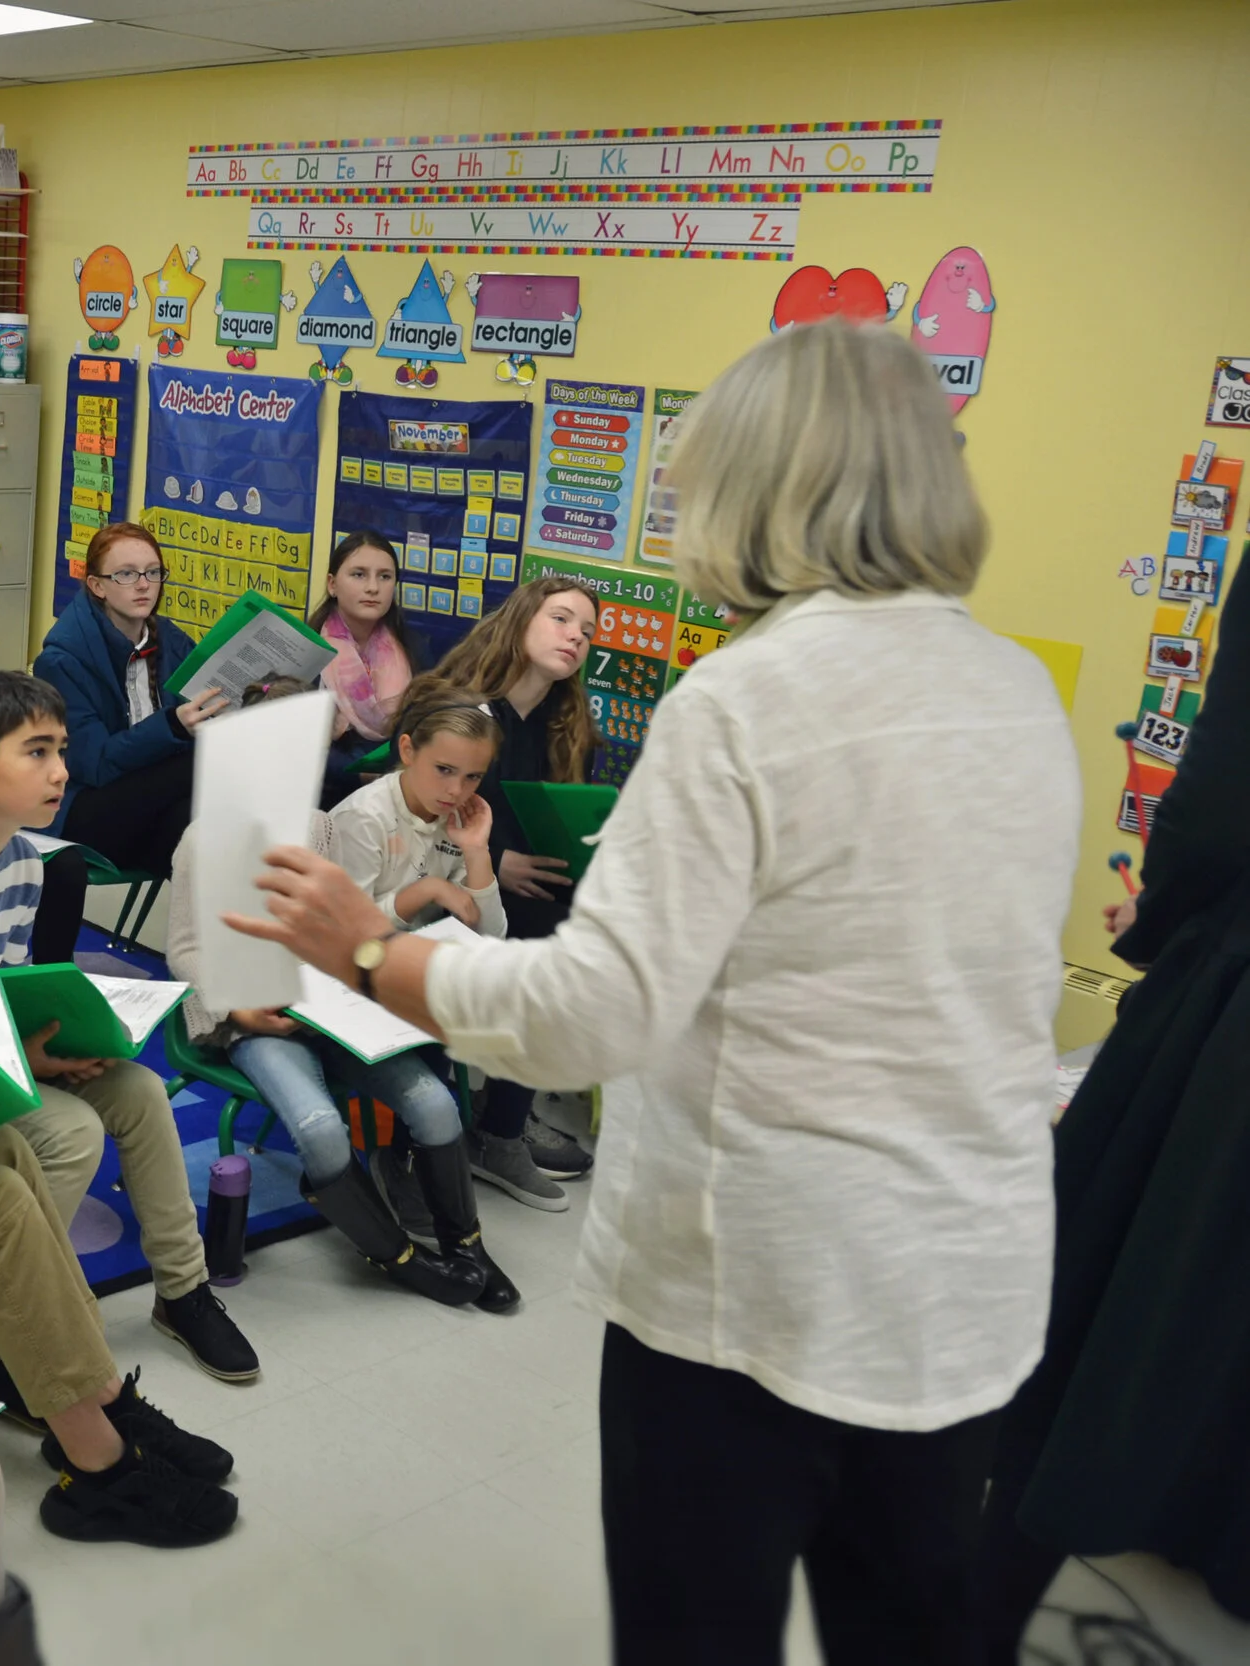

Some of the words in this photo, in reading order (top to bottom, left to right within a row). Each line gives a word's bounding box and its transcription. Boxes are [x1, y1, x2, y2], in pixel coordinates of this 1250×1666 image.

[196, 162, 216, 182] Aa
[228, 159, 247, 182] Bb
[261, 158, 281, 180] Cc
[296, 157, 318, 180] Dd
[336, 157, 356, 179] Ee
[375, 155, 393, 178] Ff
[411, 154, 439, 183] Gg
[457, 153, 482, 177] Hh
[505, 151, 523, 176] Ii
[550, 151, 569, 181] Jj
[600, 148, 628, 174] Kk
[660, 147, 682, 174] Ll
[708, 147, 751, 173] Mm
[769, 144, 805, 173] Nn
[825, 142, 866, 172] Oo
[888, 142, 919, 178] Pp
[258, 212, 282, 240] Qq
[299, 212, 316, 235] Rr
[334, 213, 353, 235] Ss
[375, 213, 390, 235] Tt
[410, 213, 434, 236] Uu
[470, 212, 494, 235] Vv
[528, 212, 569, 236] Ww
[594, 212, 625, 238] Xx
[672, 213, 699, 251] Yy
[748, 213, 783, 242] Zz
[87, 295, 122, 313] circle
[158, 300, 184, 320] star
[222, 318, 273, 340] square
[299, 319, 373, 339] diamond
[388, 322, 457, 349] triangle
[475, 322, 572, 349] rectangle
[937, 360, 975, 385] val
[161, 382, 233, 415] Alphabet
[239, 392, 294, 420] Center
[553, 386, 575, 400] Days
[579, 391, 589, 400] of
[591, 391, 606, 401] the
[610, 393, 636, 405] Week
[1218, 386, 1250, 400] Clas
[573, 414, 610, 428] Sunday
[398, 424, 460, 442] November
[570, 434, 609, 448] Monday
[567, 453, 607, 468] Tuesday
[557, 471, 613, 488] Wednesday
[561, 491, 604, 507] Thursday
[475, 520, 479, 529] 1
[503, 523, 509, 532] 2
[565, 511, 595, 525] Friday
[159, 518, 175, 537] Bb
[180, 522, 198, 541] Cc
[201, 526, 220, 546] Dd
[226, 531, 243, 550] Ee
[250, 535, 269, 553] Ff
[277, 536, 299, 563] Gg
[555, 529, 599, 545] Saturday
[1190, 522, 1201, 553] Andrew
[442, 558, 447, 567] 7
[469, 560, 476, 569] 8
[500, 563, 506, 572] 9
[1118, 559, 1137, 578] A
[1141, 557, 1156, 576] B
[180, 555, 194, 582] Jj
[203, 563, 219, 582] Kk
[247, 572, 271, 592] Mm
[277, 579, 296, 600] Nn
[542, 566, 610, 593] Nmbers
[614, 580, 654, 601] 1-10
[1131, 578, 1149, 595] C
[201, 600, 217, 618] Rr
[436, 596, 446, 606] 14
[465, 600, 473, 609] 15
[687, 607, 694, 617] B
[699, 605, 707, 616] C
[600, 607, 616, 631] 6
[600, 634, 611, 643] six
[680, 628, 701, 644] Aa
[596, 651, 611, 675] 7
[588, 677, 611, 689] seven
[590, 695, 604, 719] 8
[1164, 687, 1175, 708] Jack
[1144, 717, 1185, 750] 123
